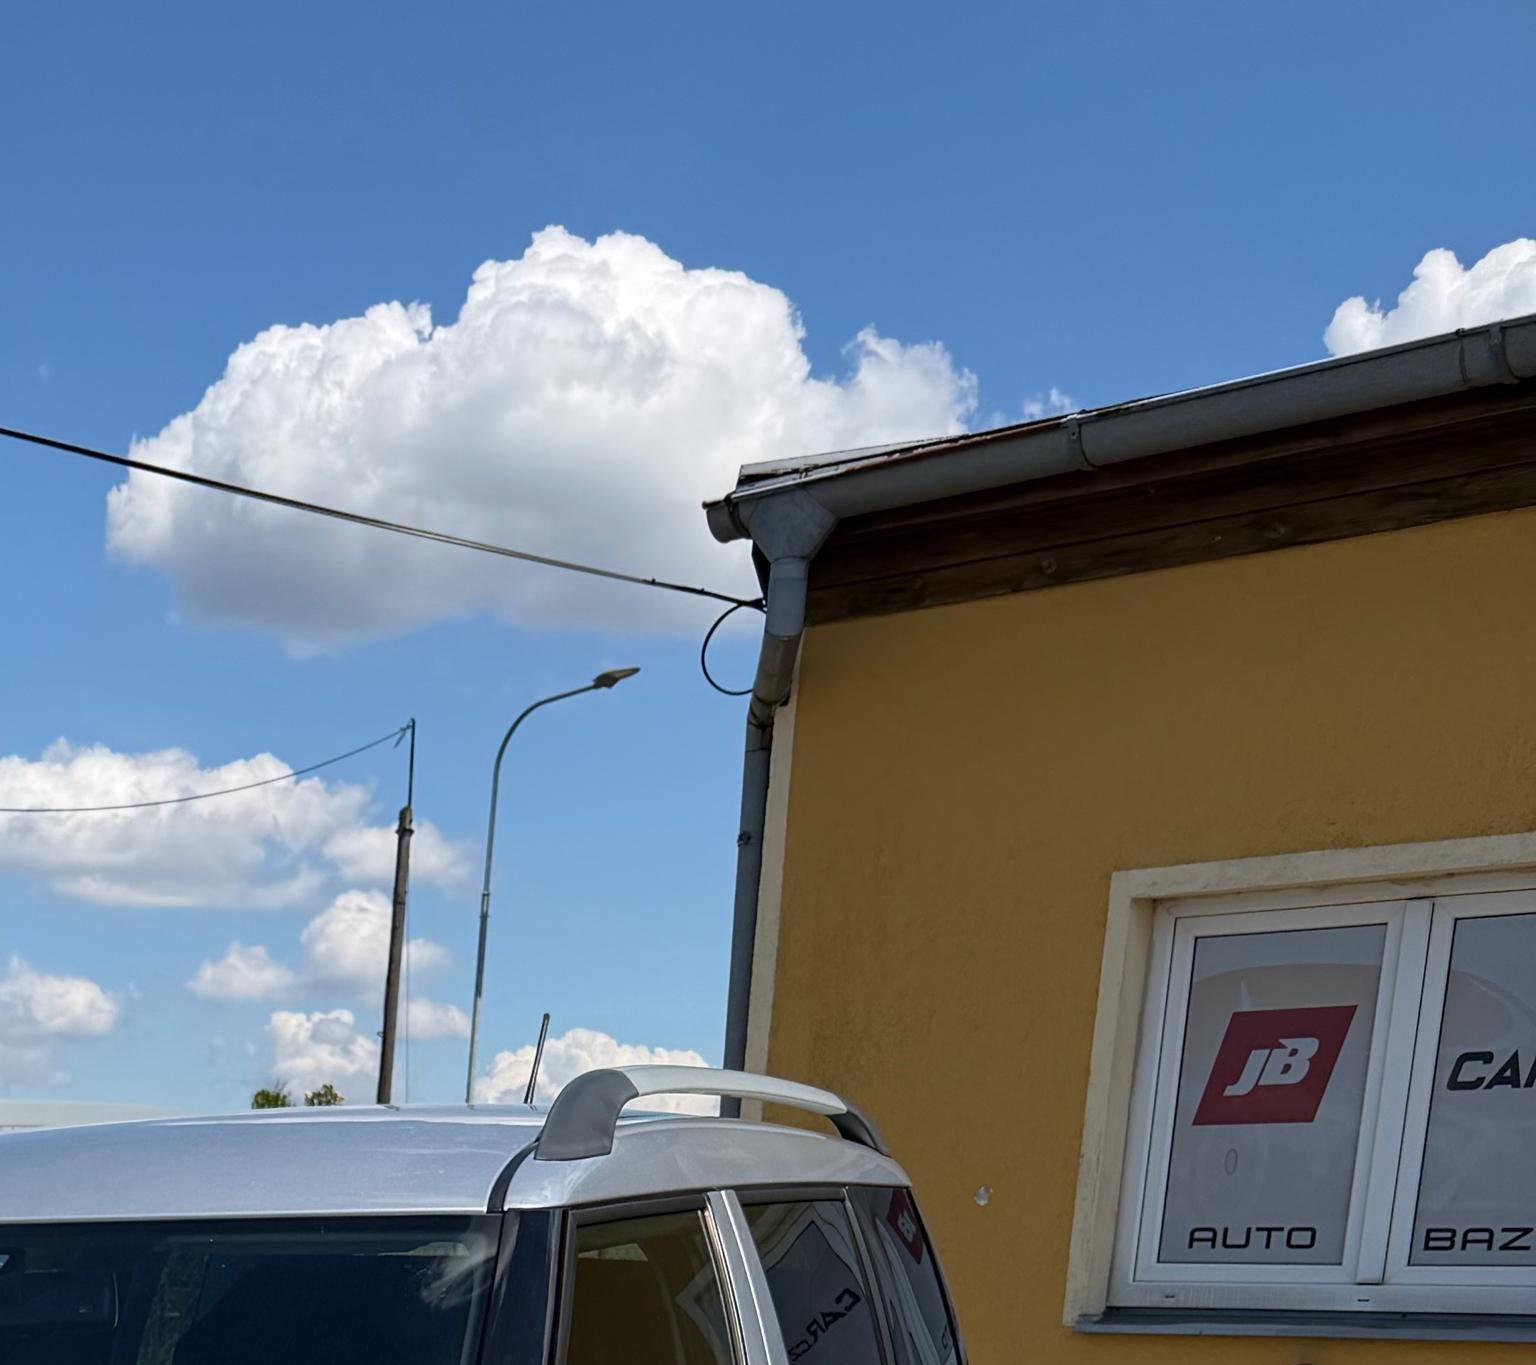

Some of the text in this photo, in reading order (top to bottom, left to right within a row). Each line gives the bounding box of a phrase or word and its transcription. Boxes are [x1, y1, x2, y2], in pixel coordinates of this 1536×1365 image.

[1222, 1036, 1320, 1097] JB
[1187, 1226, 1534, 1251] AUTO BAZ
